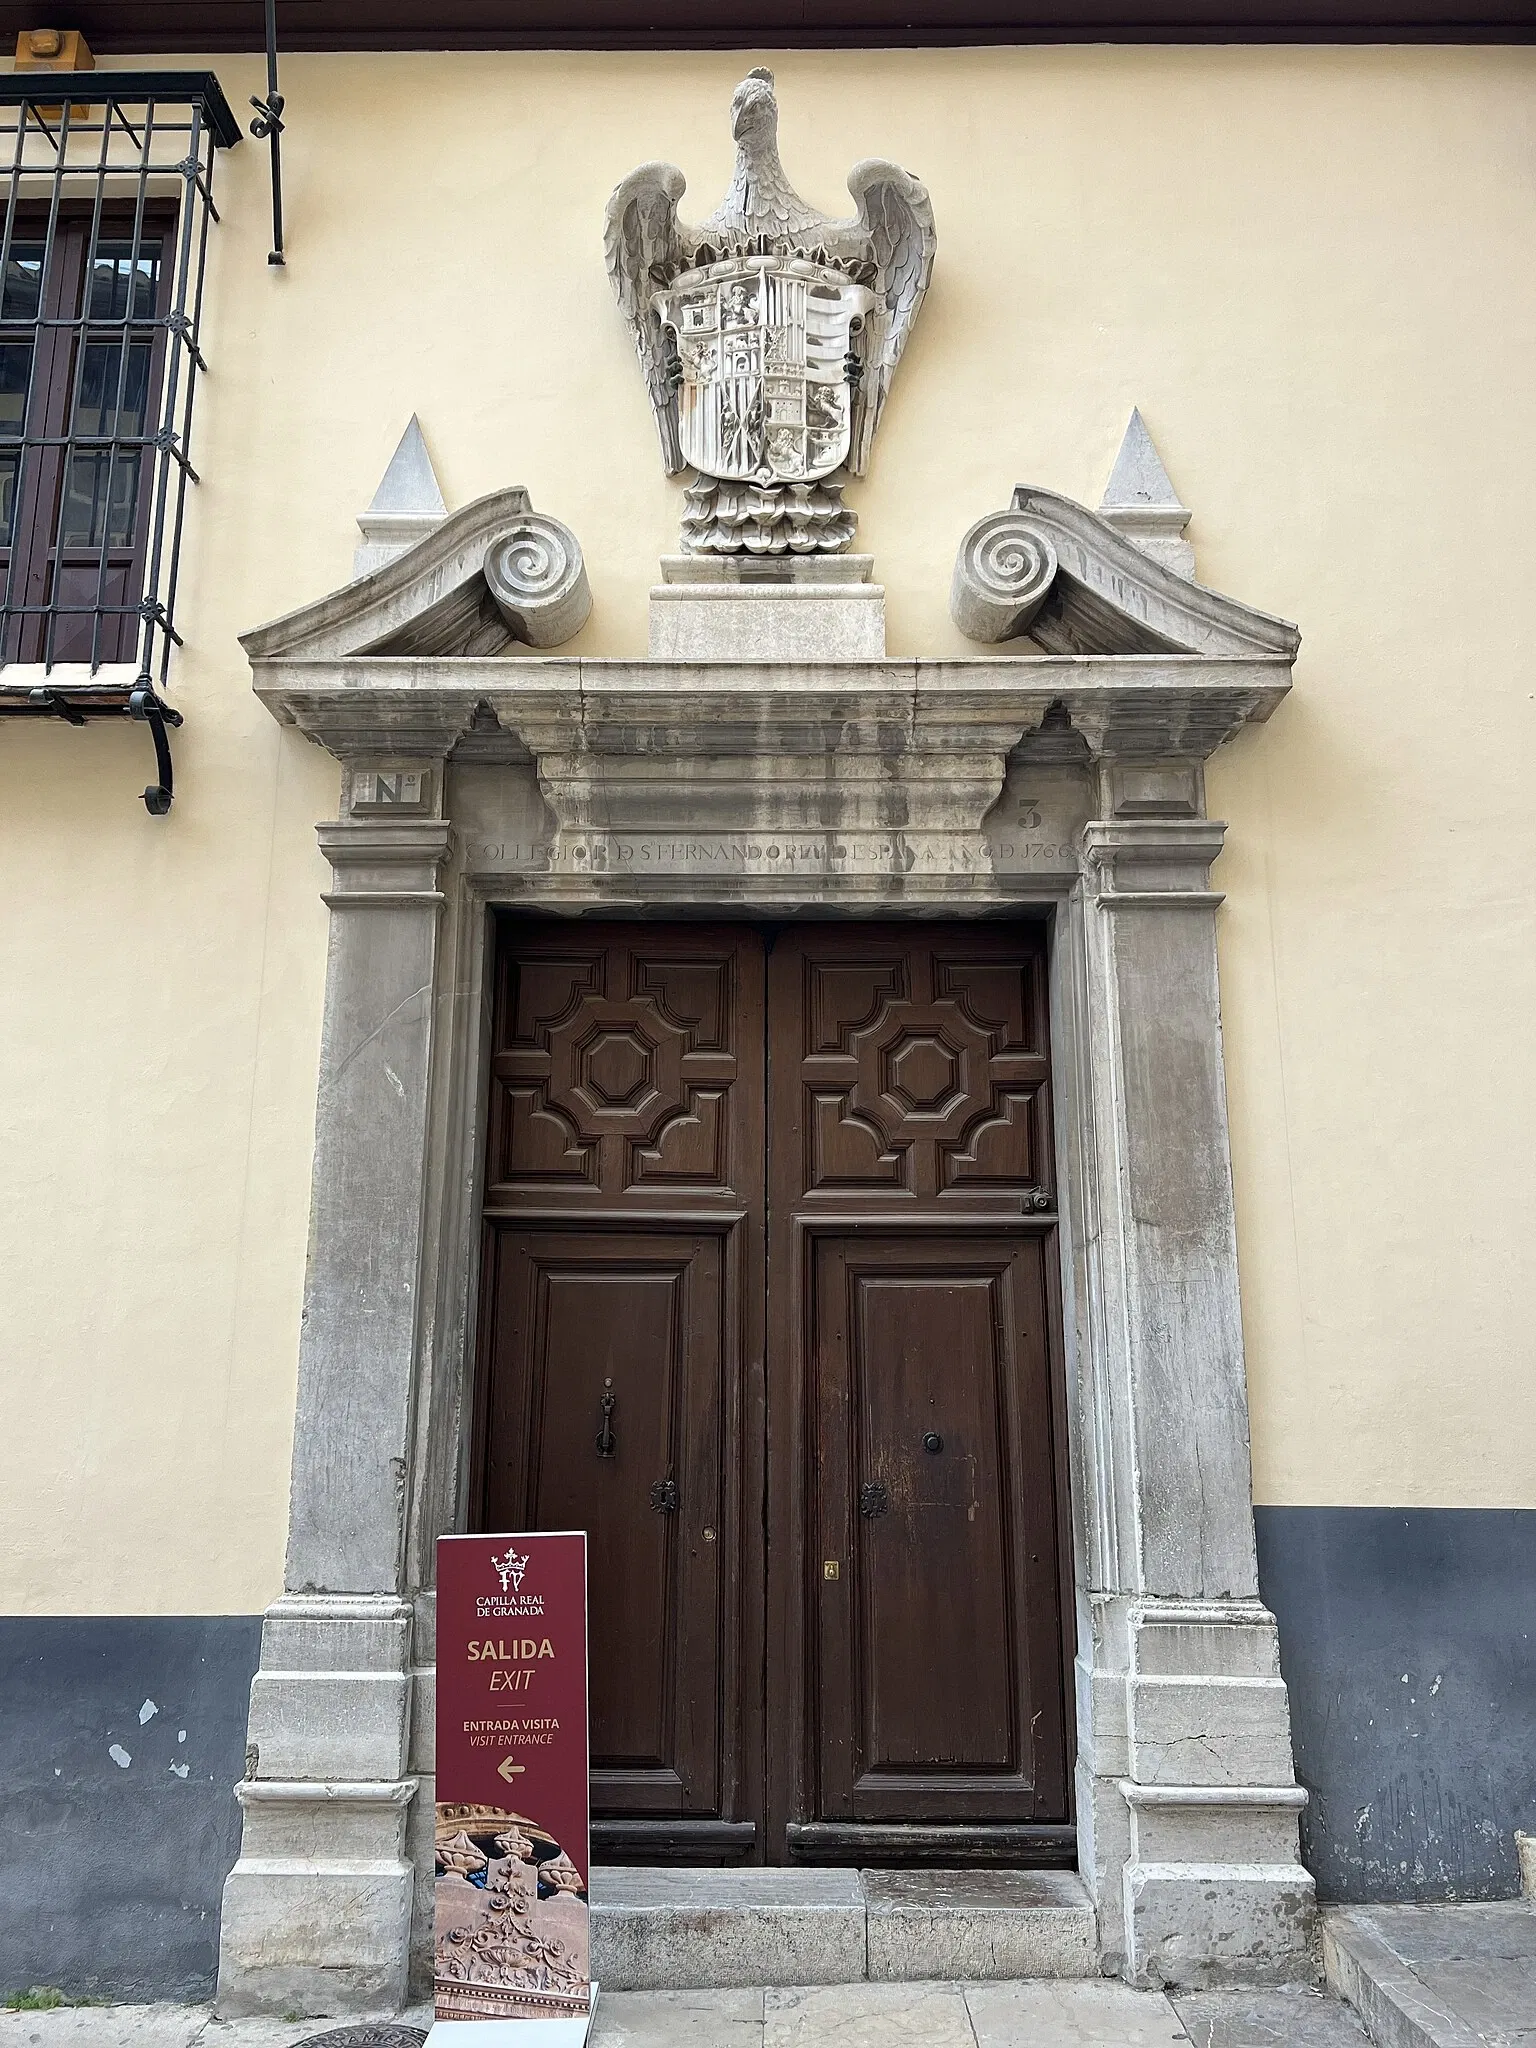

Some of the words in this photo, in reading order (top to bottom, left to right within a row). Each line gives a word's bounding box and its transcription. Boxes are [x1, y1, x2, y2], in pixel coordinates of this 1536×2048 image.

[1017, 799, 1042, 829] 3
[476, 1596, 517, 1607] CAPILLA
[520, 1595, 545, 1605] REAL
[477, 1607, 491, 1617] DE
[493, 1606, 545, 1616] GRANADA
[467, 1638, 555, 1661] SALIDA
[489, 1669, 536, 1691] EXIT
[463, 1720, 520, 1732] ENTRADA
[522, 1718, 560, 1730] VISITA
[470, 1735, 496, 1747] VISIT
[498, 1733, 554, 1746] ENTRANCE
